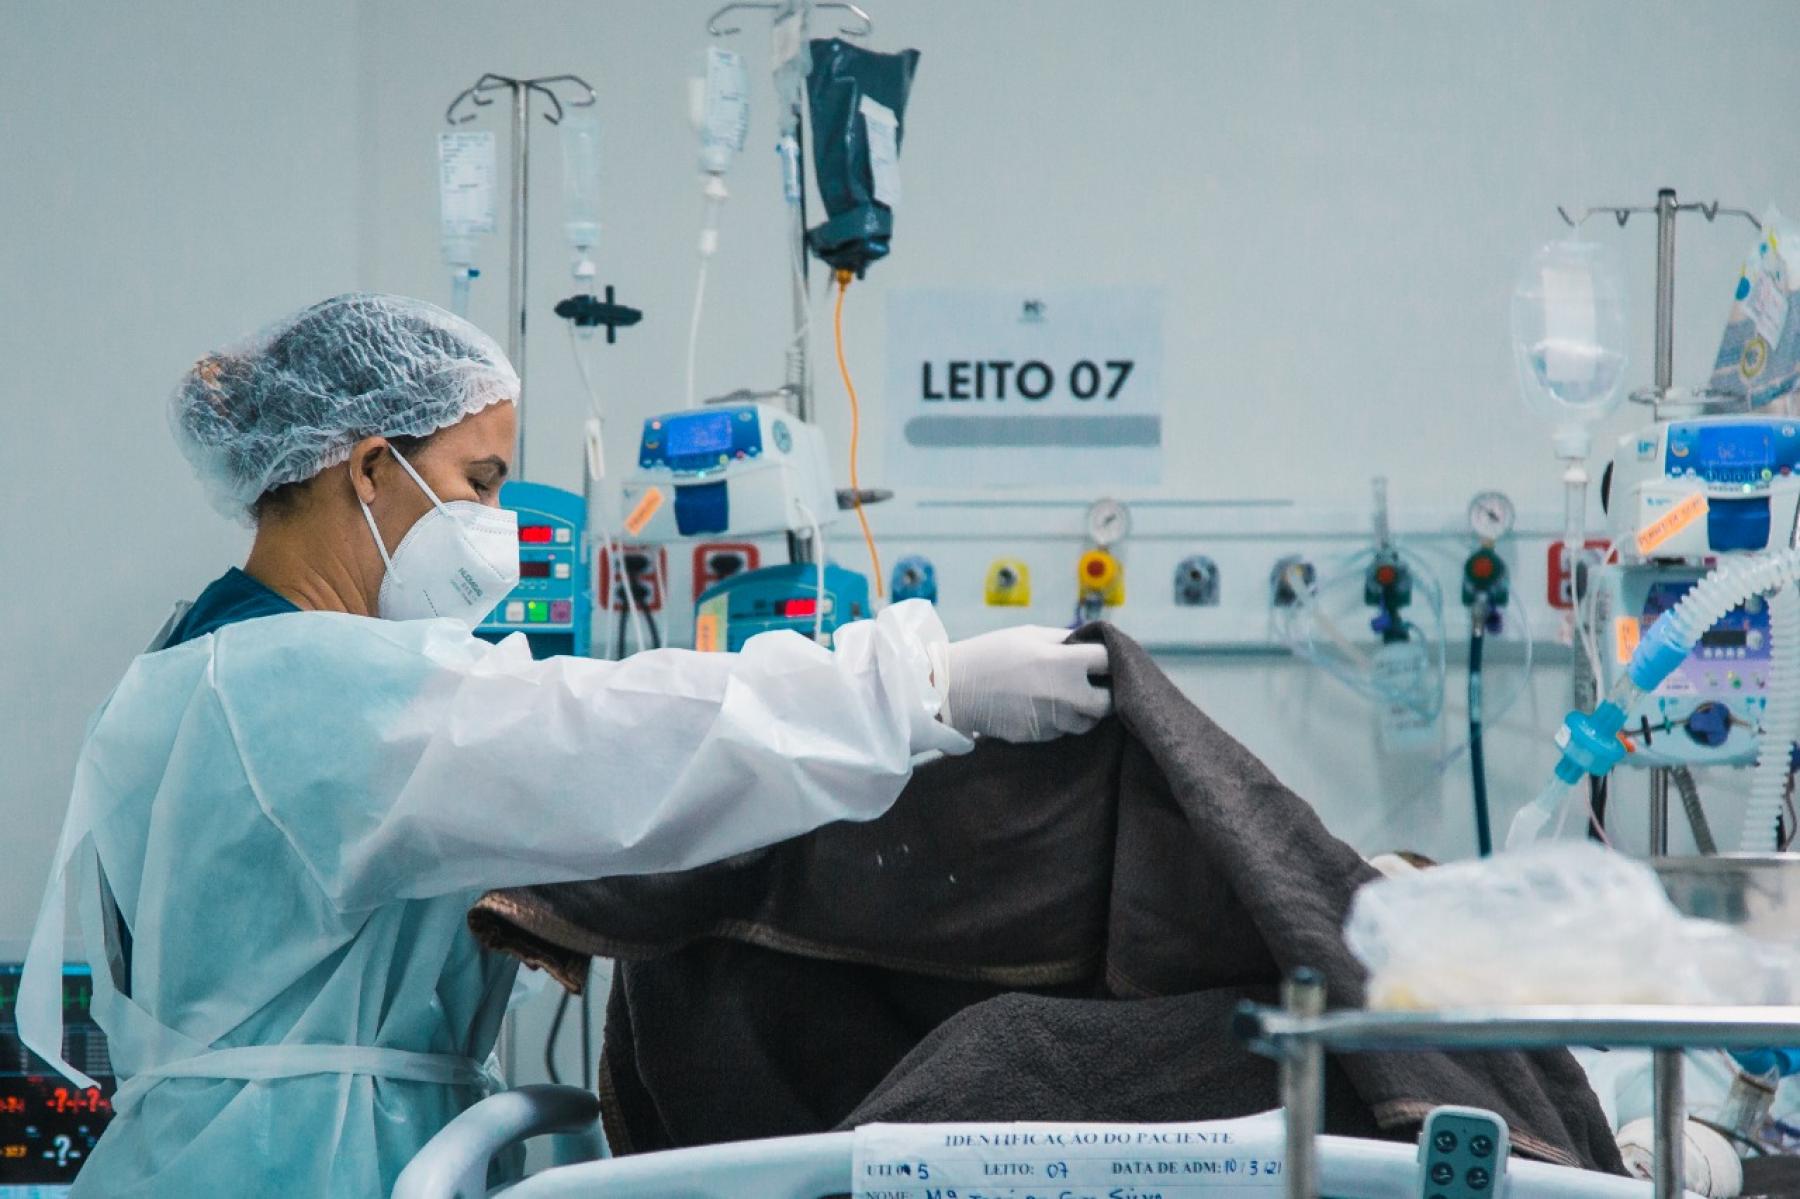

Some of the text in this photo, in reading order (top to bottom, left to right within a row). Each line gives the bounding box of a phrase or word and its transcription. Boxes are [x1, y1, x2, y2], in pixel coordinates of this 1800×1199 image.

[922, 360, 1135, 401] LEITO 07
[1104, 1132, 1131, 1145] DO
[1137, 1131, 1235, 1145] PACIENTE
[917, 1163, 929, 1180] 5
[983, 1161, 1069, 1179] LEITO: 07
[1112, 1161, 1154, 1175] DATA
[1157, 1161, 1179, 1174] DE
